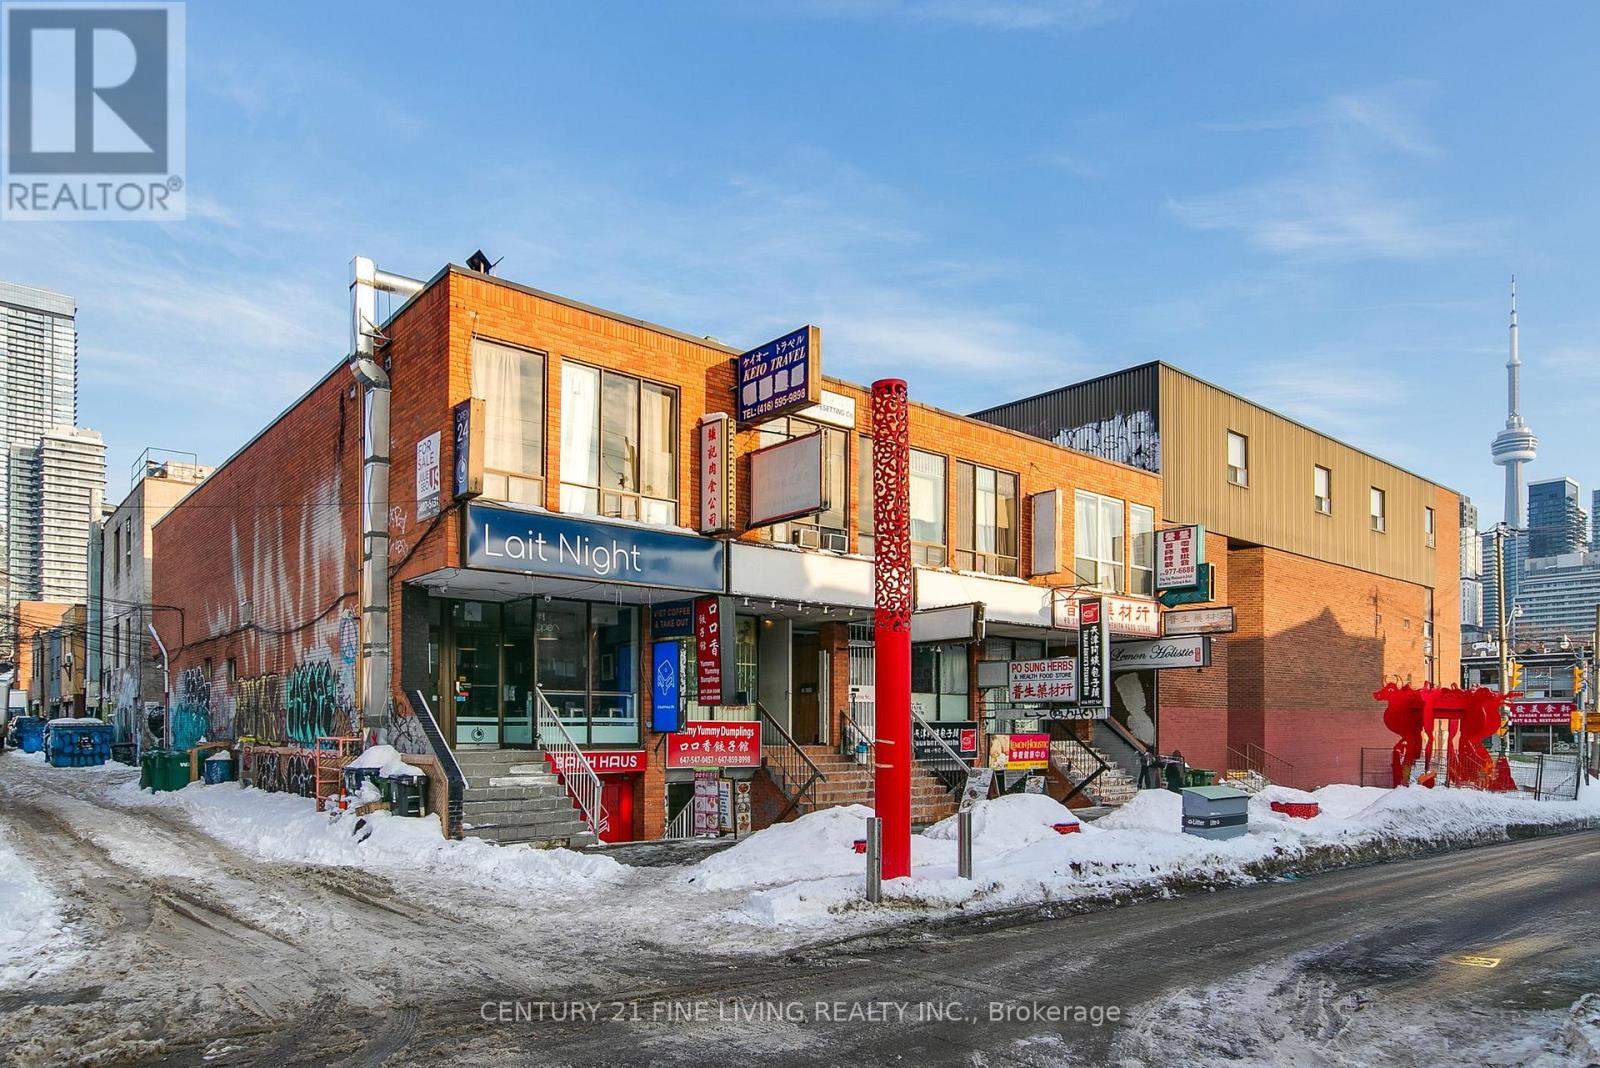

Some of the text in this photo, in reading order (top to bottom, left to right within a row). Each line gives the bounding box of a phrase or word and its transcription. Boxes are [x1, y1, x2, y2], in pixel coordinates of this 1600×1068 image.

[743, 346, 806, 382] KEIO TRAVEL
[757, 402, 774, 415] (416)
[457, 421, 469, 442] 24
[418, 440, 431, 455] FOR
[418, 452, 434, 470] SALE
[485, 523, 642, 575] Lait Night
[1111, 648, 1147, 662] Lemon
[1149, 644, 1194, 660] Holistic
[1011, 660, 1074, 673] PO SUNG HERBS
[697, 725, 720, 738] Yummy
[720, 725, 755, 739] Dumplings
[600, 756, 638, 768] HAUS
